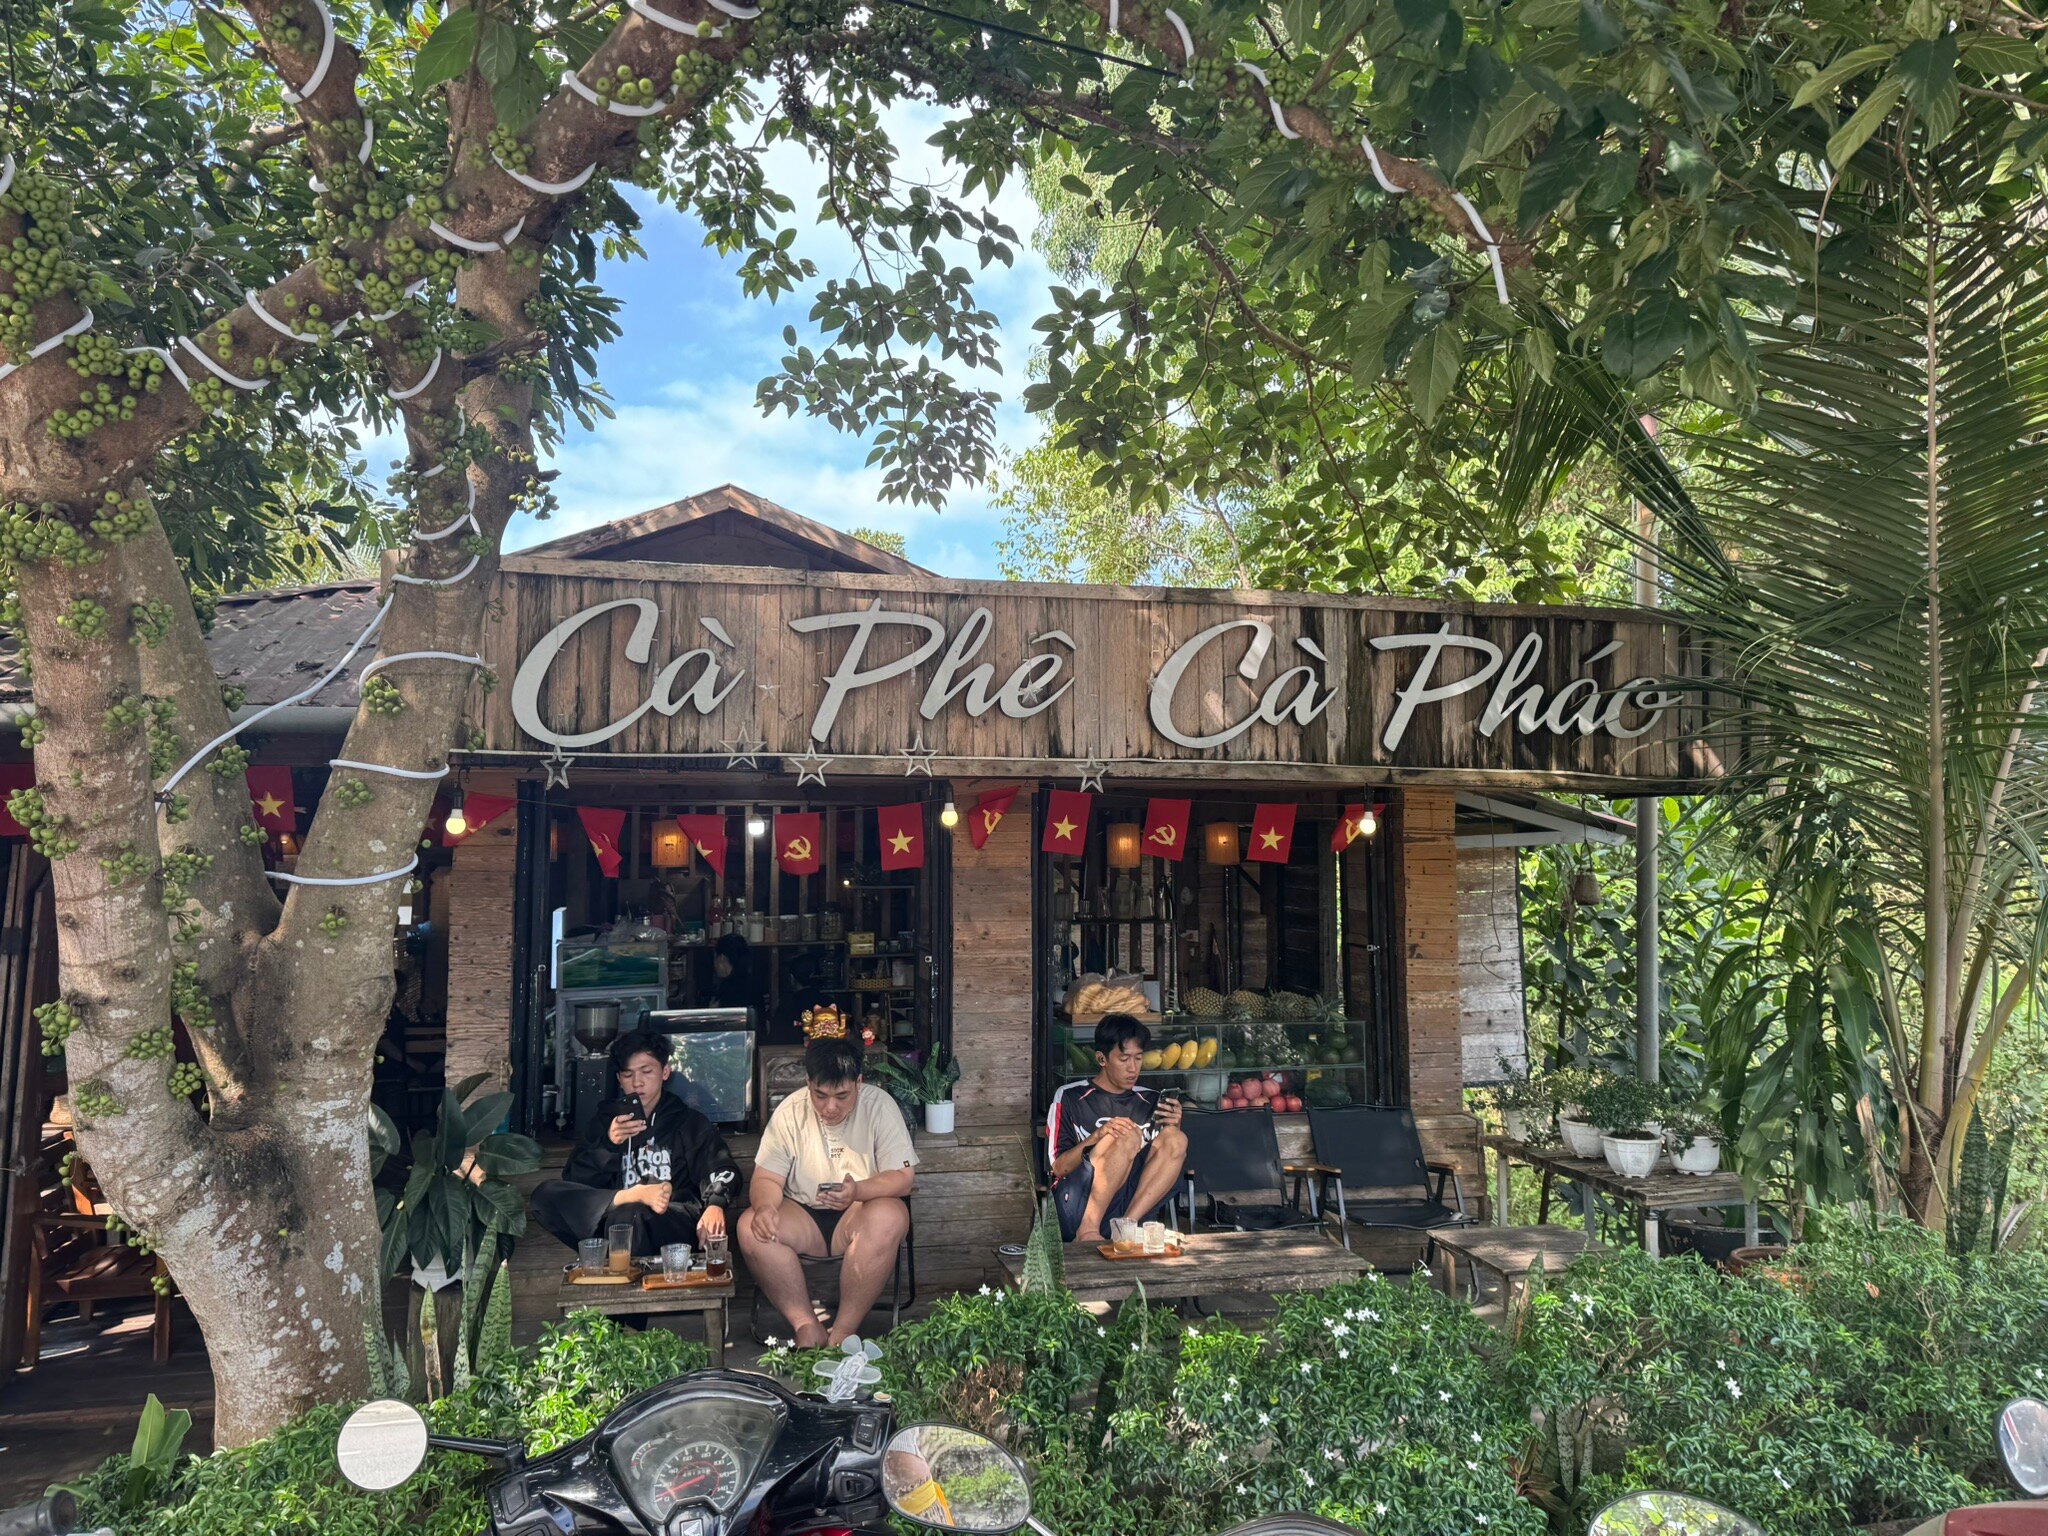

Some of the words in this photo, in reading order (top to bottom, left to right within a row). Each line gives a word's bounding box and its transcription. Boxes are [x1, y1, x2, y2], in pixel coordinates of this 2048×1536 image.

[511, 597, 745, 748] Cà
[788, 597, 1076, 742] Phê
[1148, 620, 1339, 749] Cà
[1369, 622, 1684, 752] Pháo
